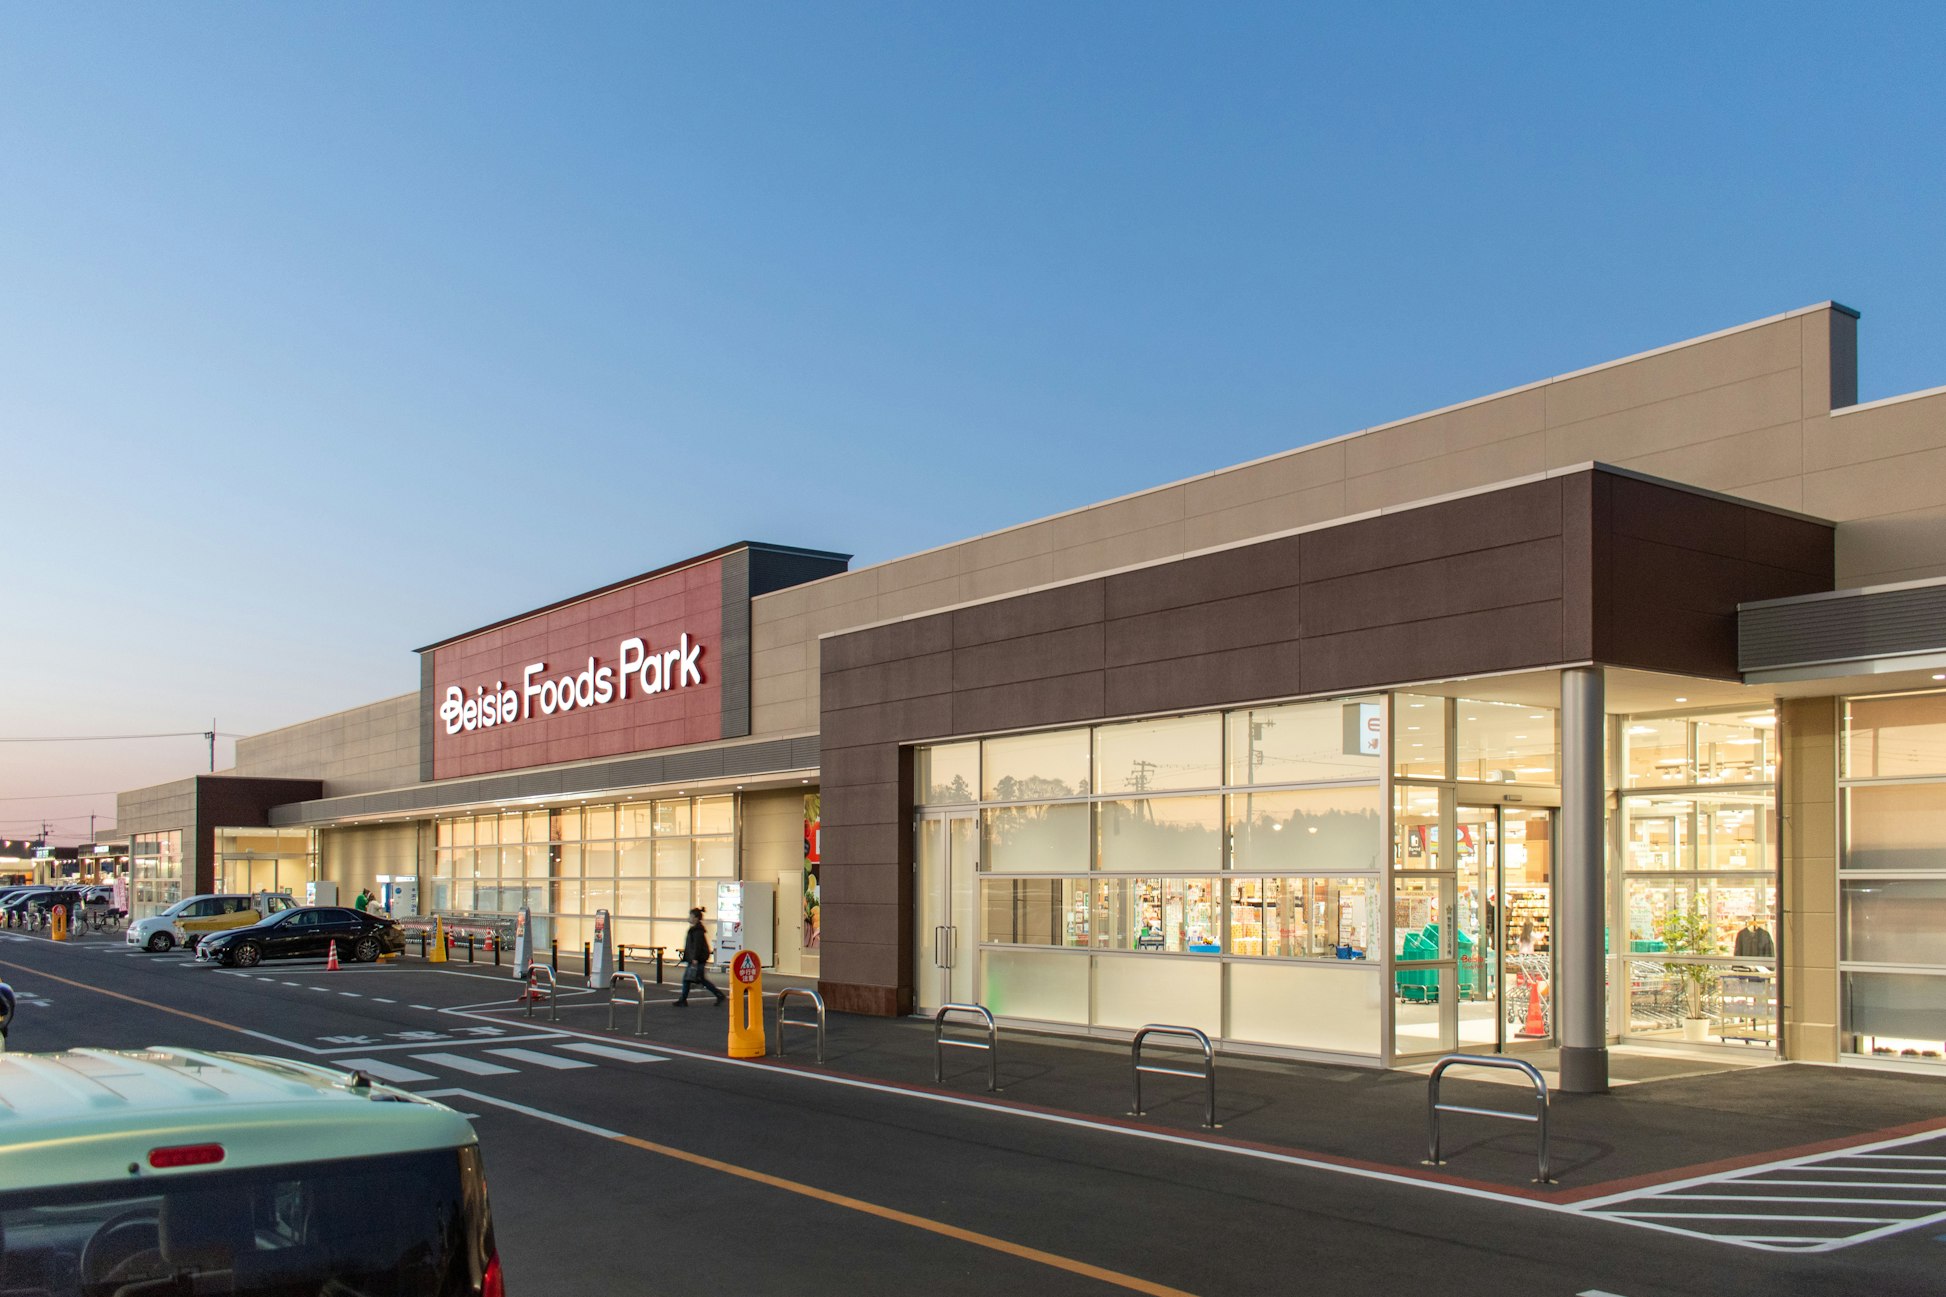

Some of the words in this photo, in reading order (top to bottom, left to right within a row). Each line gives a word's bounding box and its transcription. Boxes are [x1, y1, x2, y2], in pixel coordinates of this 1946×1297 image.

[439, 680, 519, 735] Beisia
[523, 656, 614, 719] Foods
[619, 632, 703, 700] Park
